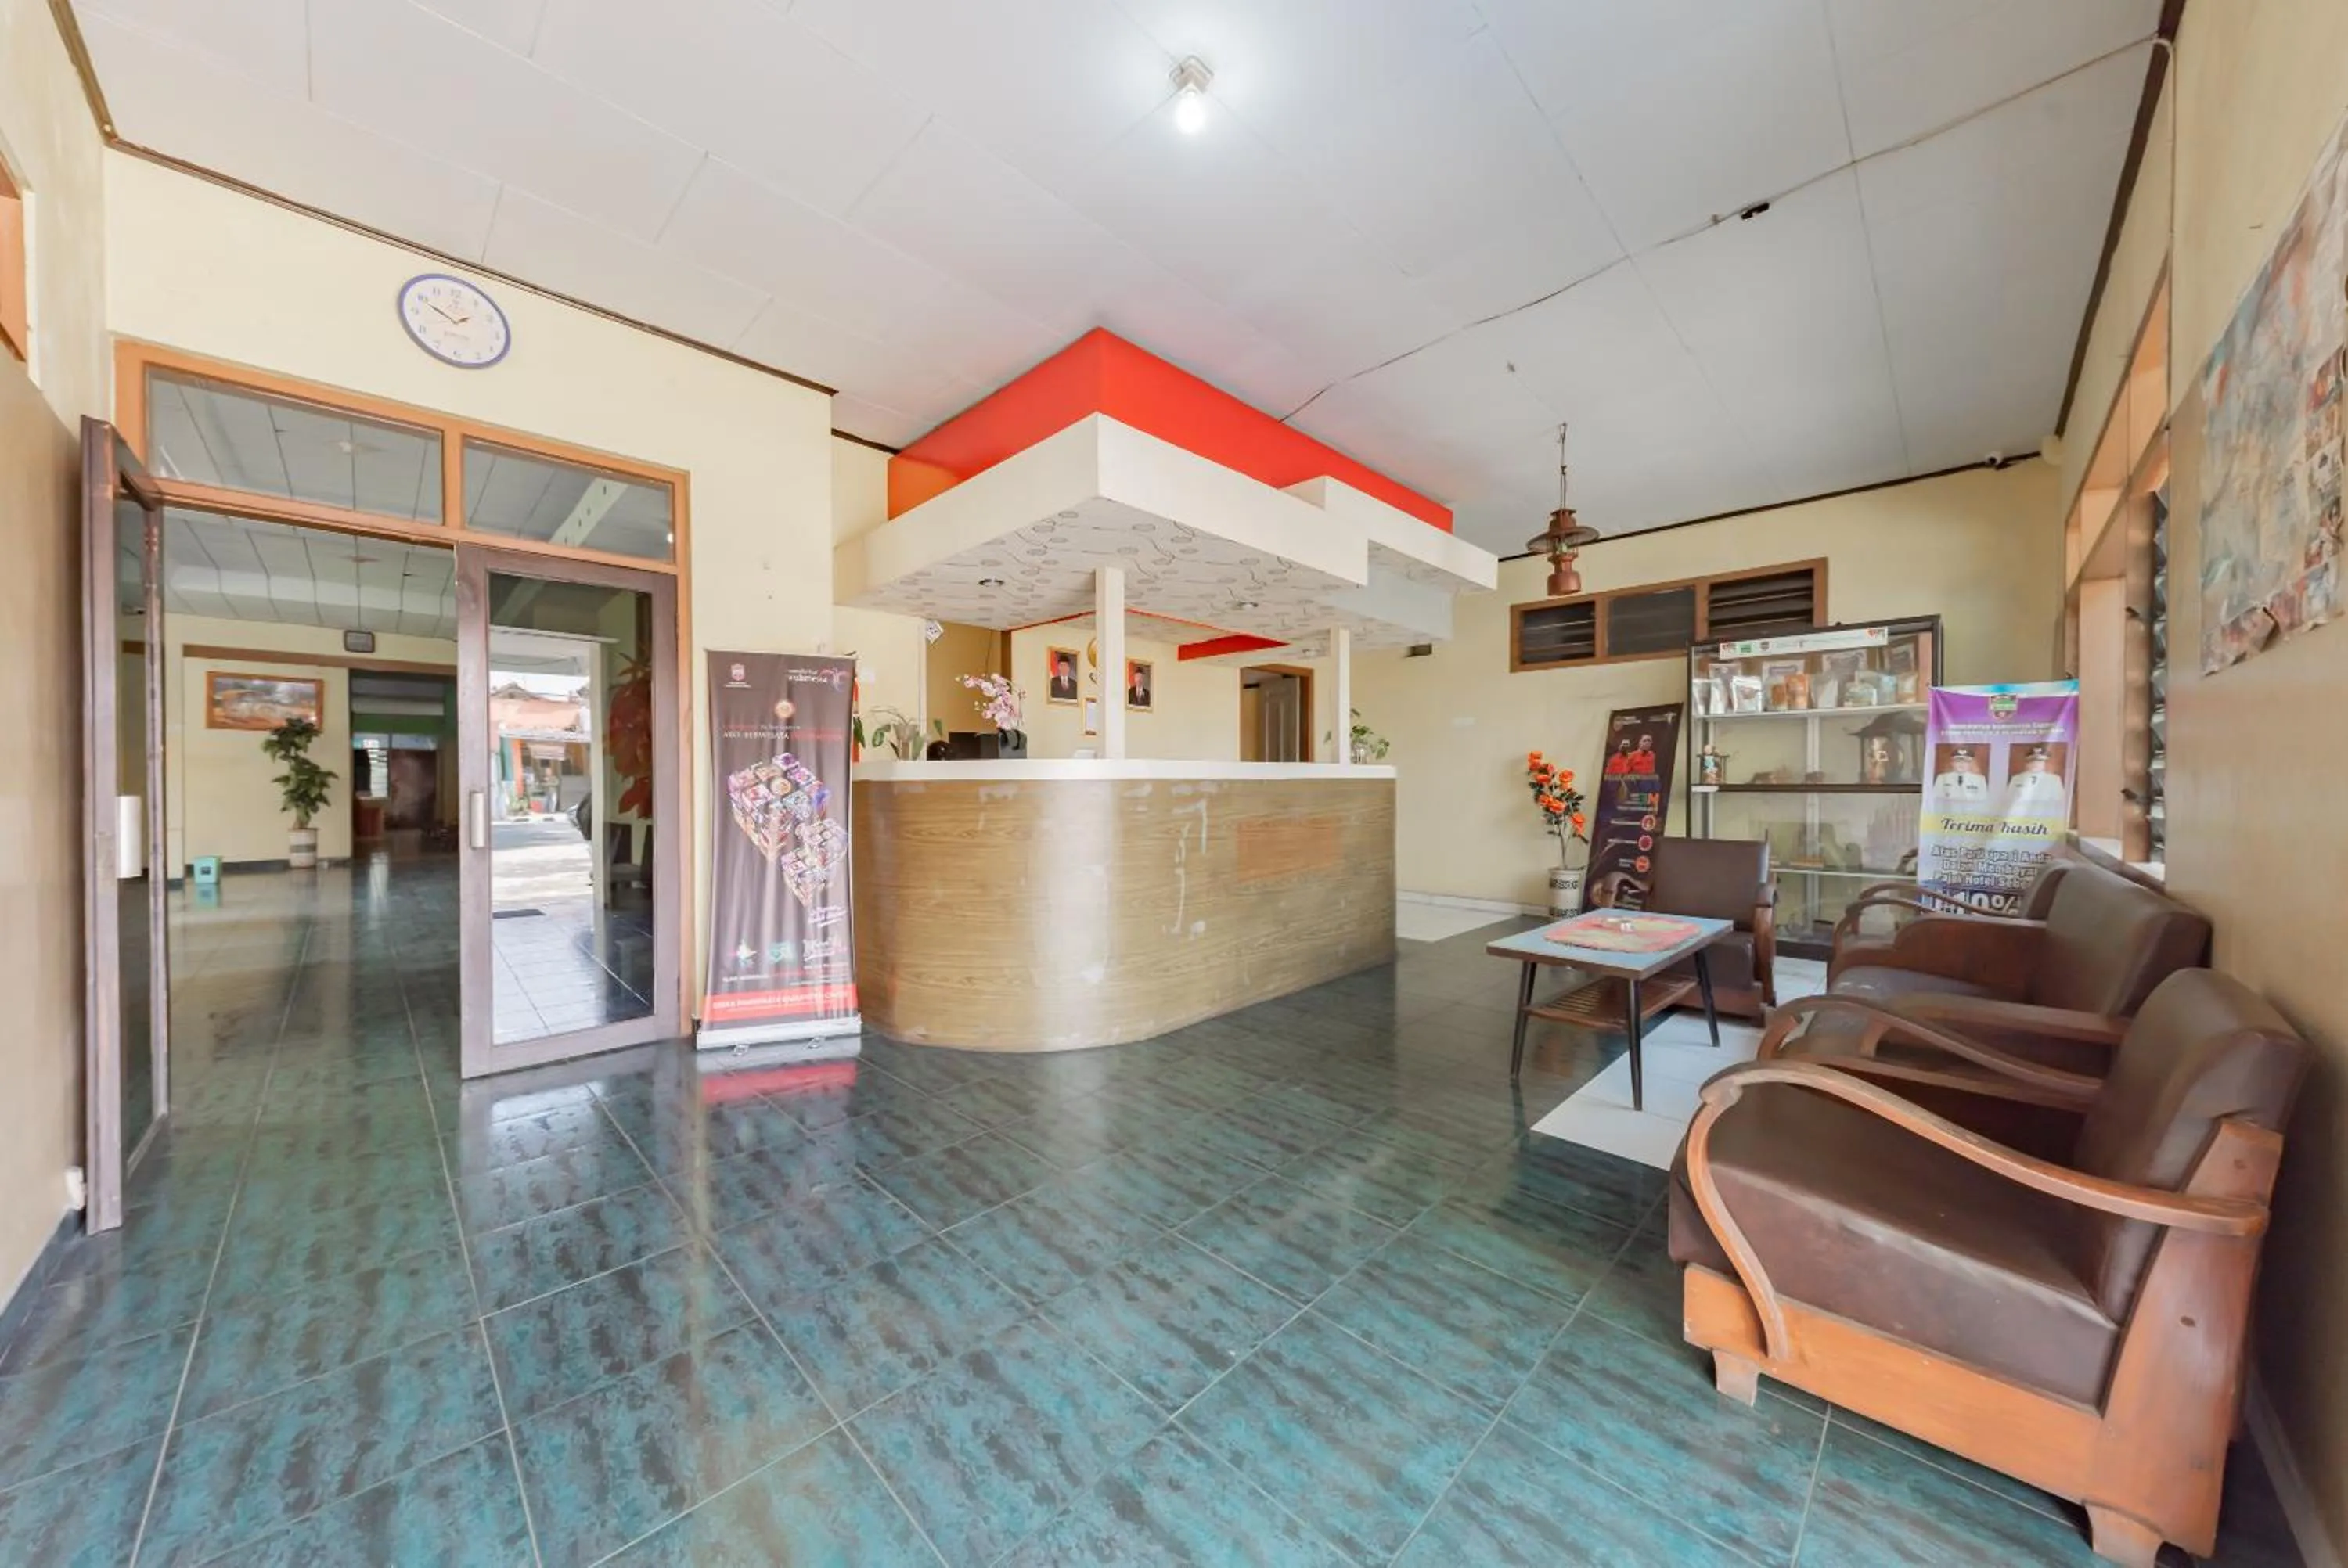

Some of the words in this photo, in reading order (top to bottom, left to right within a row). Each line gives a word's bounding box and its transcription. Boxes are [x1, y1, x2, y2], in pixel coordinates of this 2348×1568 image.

[1941, 818, 1995, 833] Terima
[1930, 844, 1958, 858] Atas
[2021, 851, 2054, 865] Anda
[1942, 859, 1975, 872] Dalam
[1965, 873, 1997, 887] Hotel
[1997, 875, 2033, 890] Sebe
